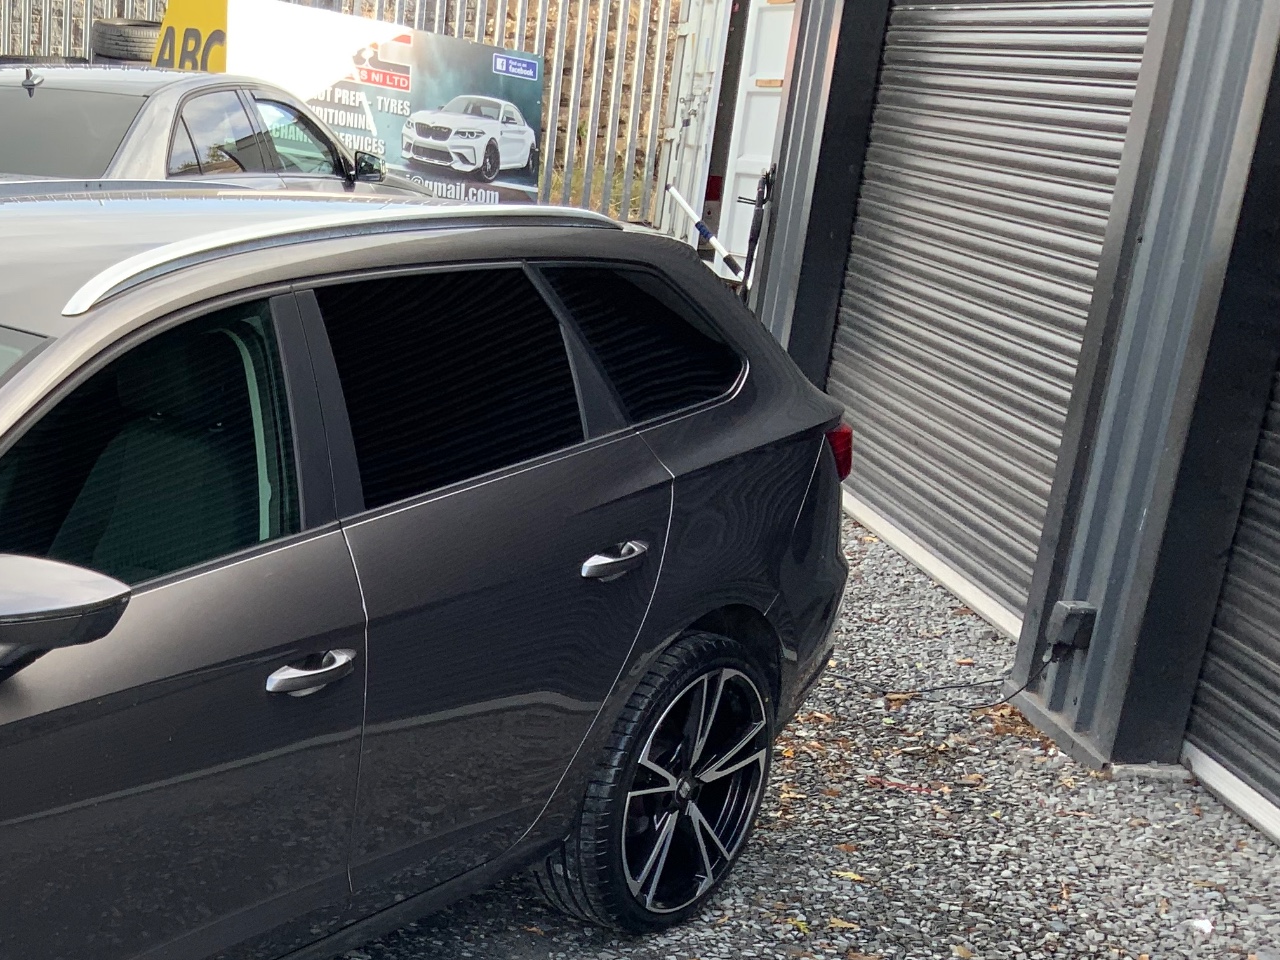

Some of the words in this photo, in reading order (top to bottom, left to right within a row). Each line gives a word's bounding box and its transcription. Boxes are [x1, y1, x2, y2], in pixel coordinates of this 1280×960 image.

[508, 65, 534, 77] facebook
[387, 75, 408, 88] LTD
[377, 95, 410, 117] TYRES
